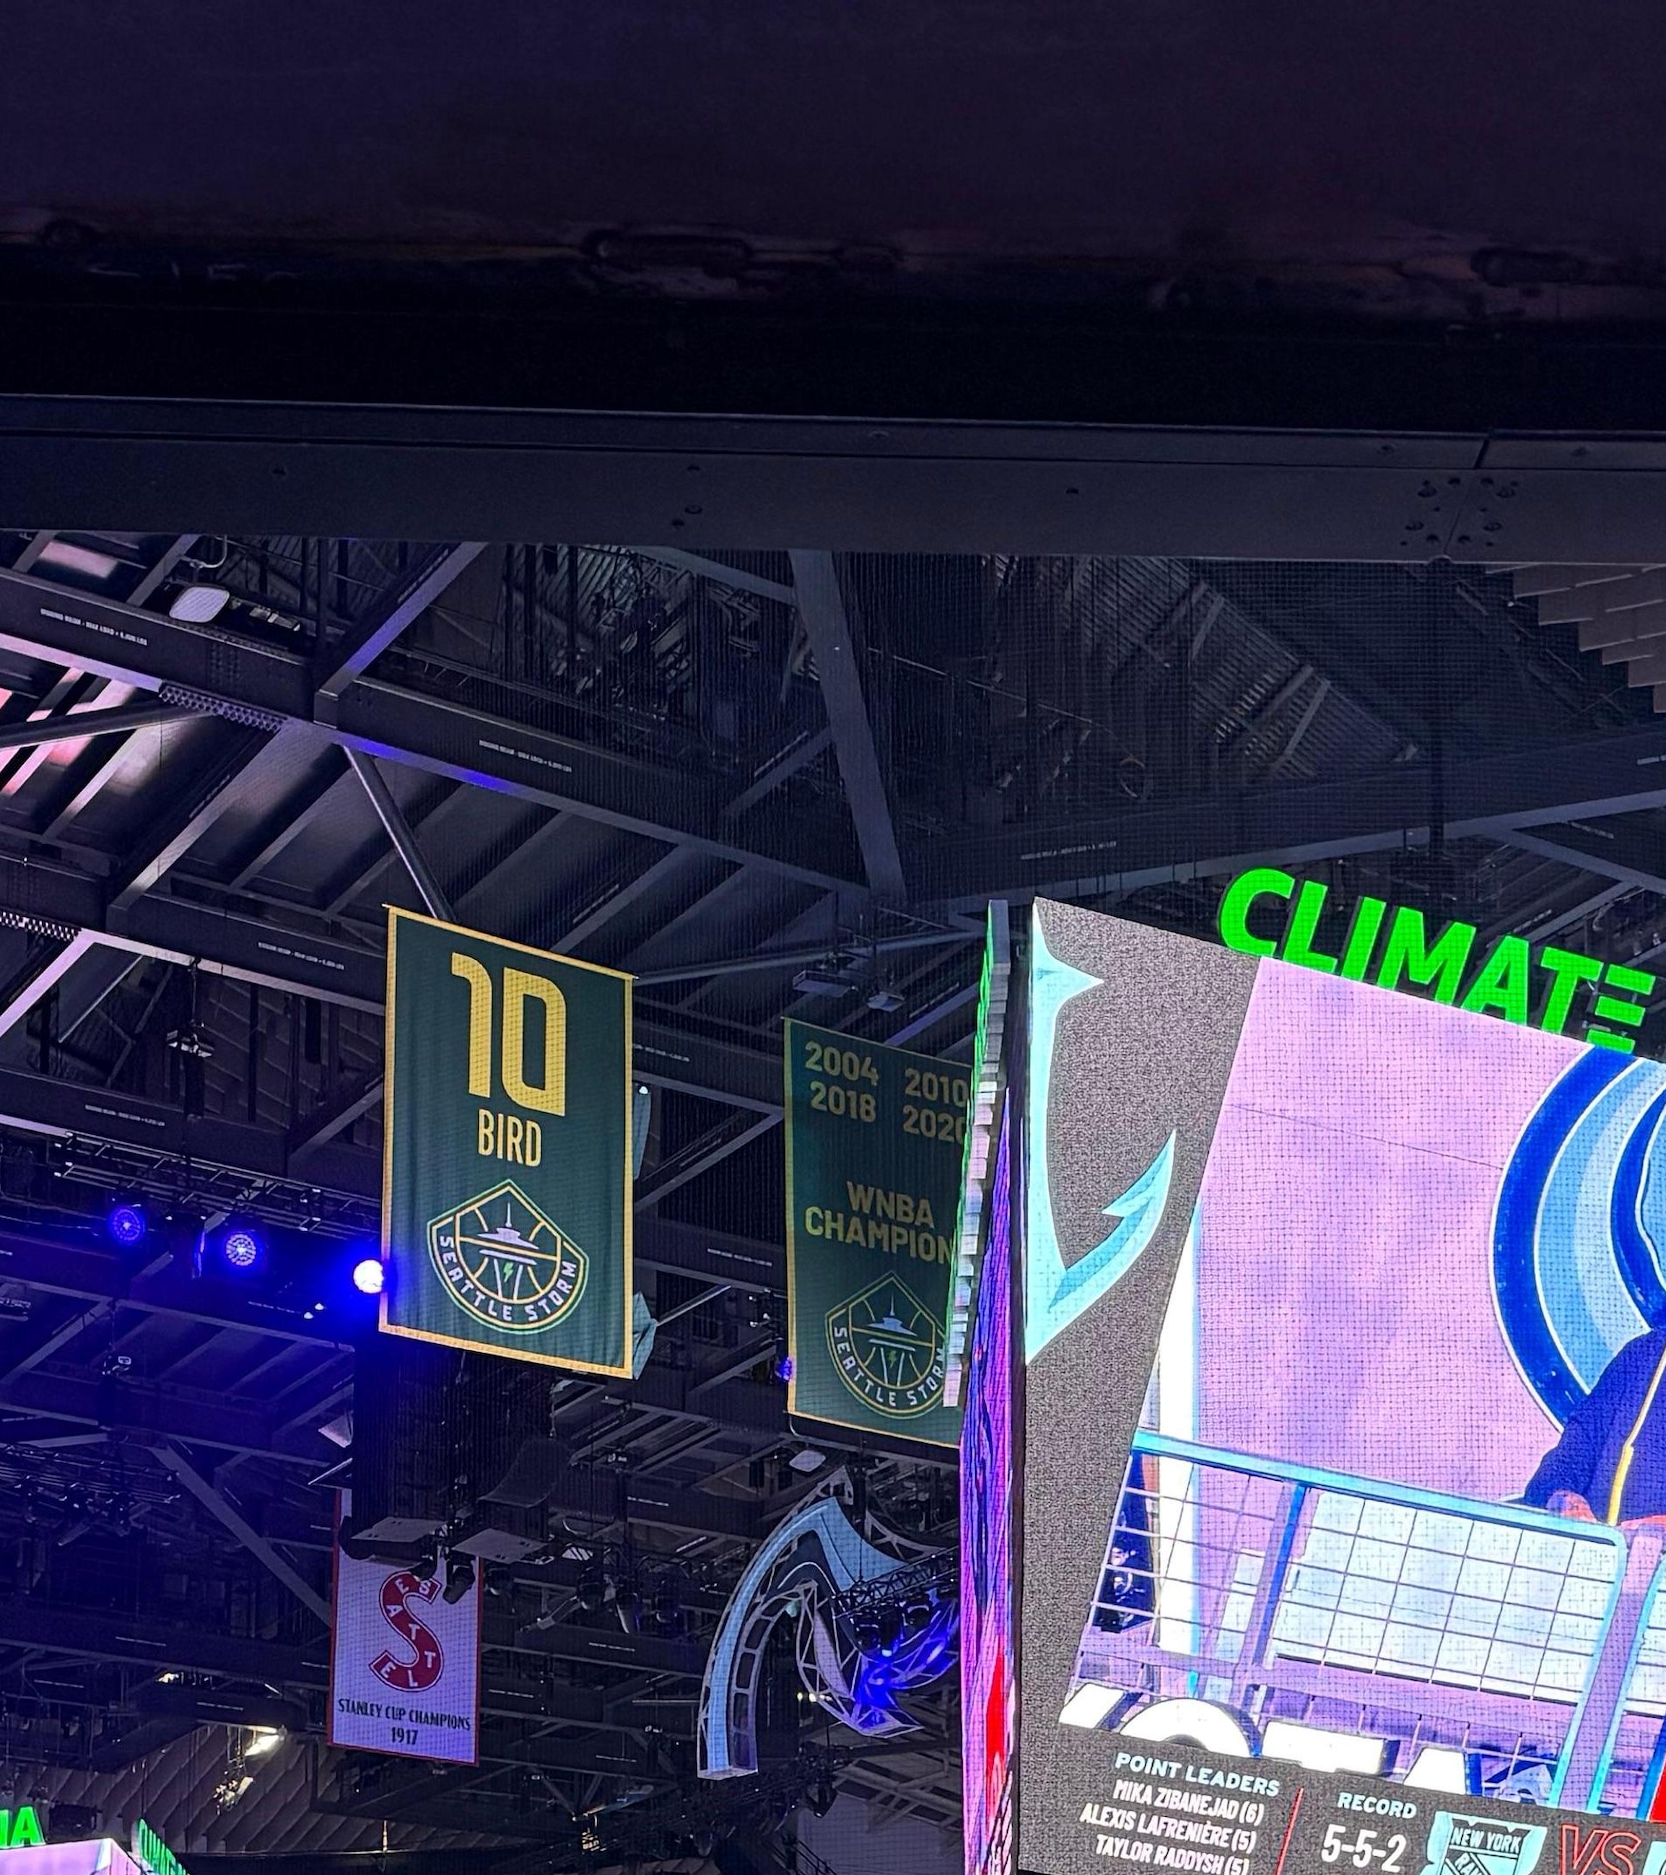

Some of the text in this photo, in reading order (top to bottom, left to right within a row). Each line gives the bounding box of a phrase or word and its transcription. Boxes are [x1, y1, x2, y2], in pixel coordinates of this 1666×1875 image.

[1217, 867, 1655, 1052] CLIMATE
[451, 952, 567, 1117] 10
[805, 1041, 969, 1107] 2004 2010
[809, 1081, 877, 1123] 2018
[478, 1108, 542, 1167] BIRD
[846, 1181, 935, 1229] WNBA
[438, 1234, 577, 1323] SEATTLE STORM
[834, 1327, 946, 1407] SEATTLE STORM
[379, 1578, 437, 1688] SEATTLE
[338, 1697, 471, 1731] STANLEY CUP CHAMPIONS
[391, 1726, 418, 1746] 1917
[1115, 1752, 1280, 1797] POINT LEADERS
[1080, 1803, 1135, 1831] ALEXIS
[1137, 1815, 1232, 1848] LAFRENIÈRE
[1113, 1780, 1264, 1826] MIKA ZIBANEJAD (6)
[1337, 1792, 1417, 1819] RECORD
[1095, 1834, 1151, 1862] TAYLOR
[1153, 1845, 1223, 1875] RADDYSH
[1321, 1823, 1407, 1873] 5-5-2
[1451, 1825, 1523, 1852] NEW YORK
